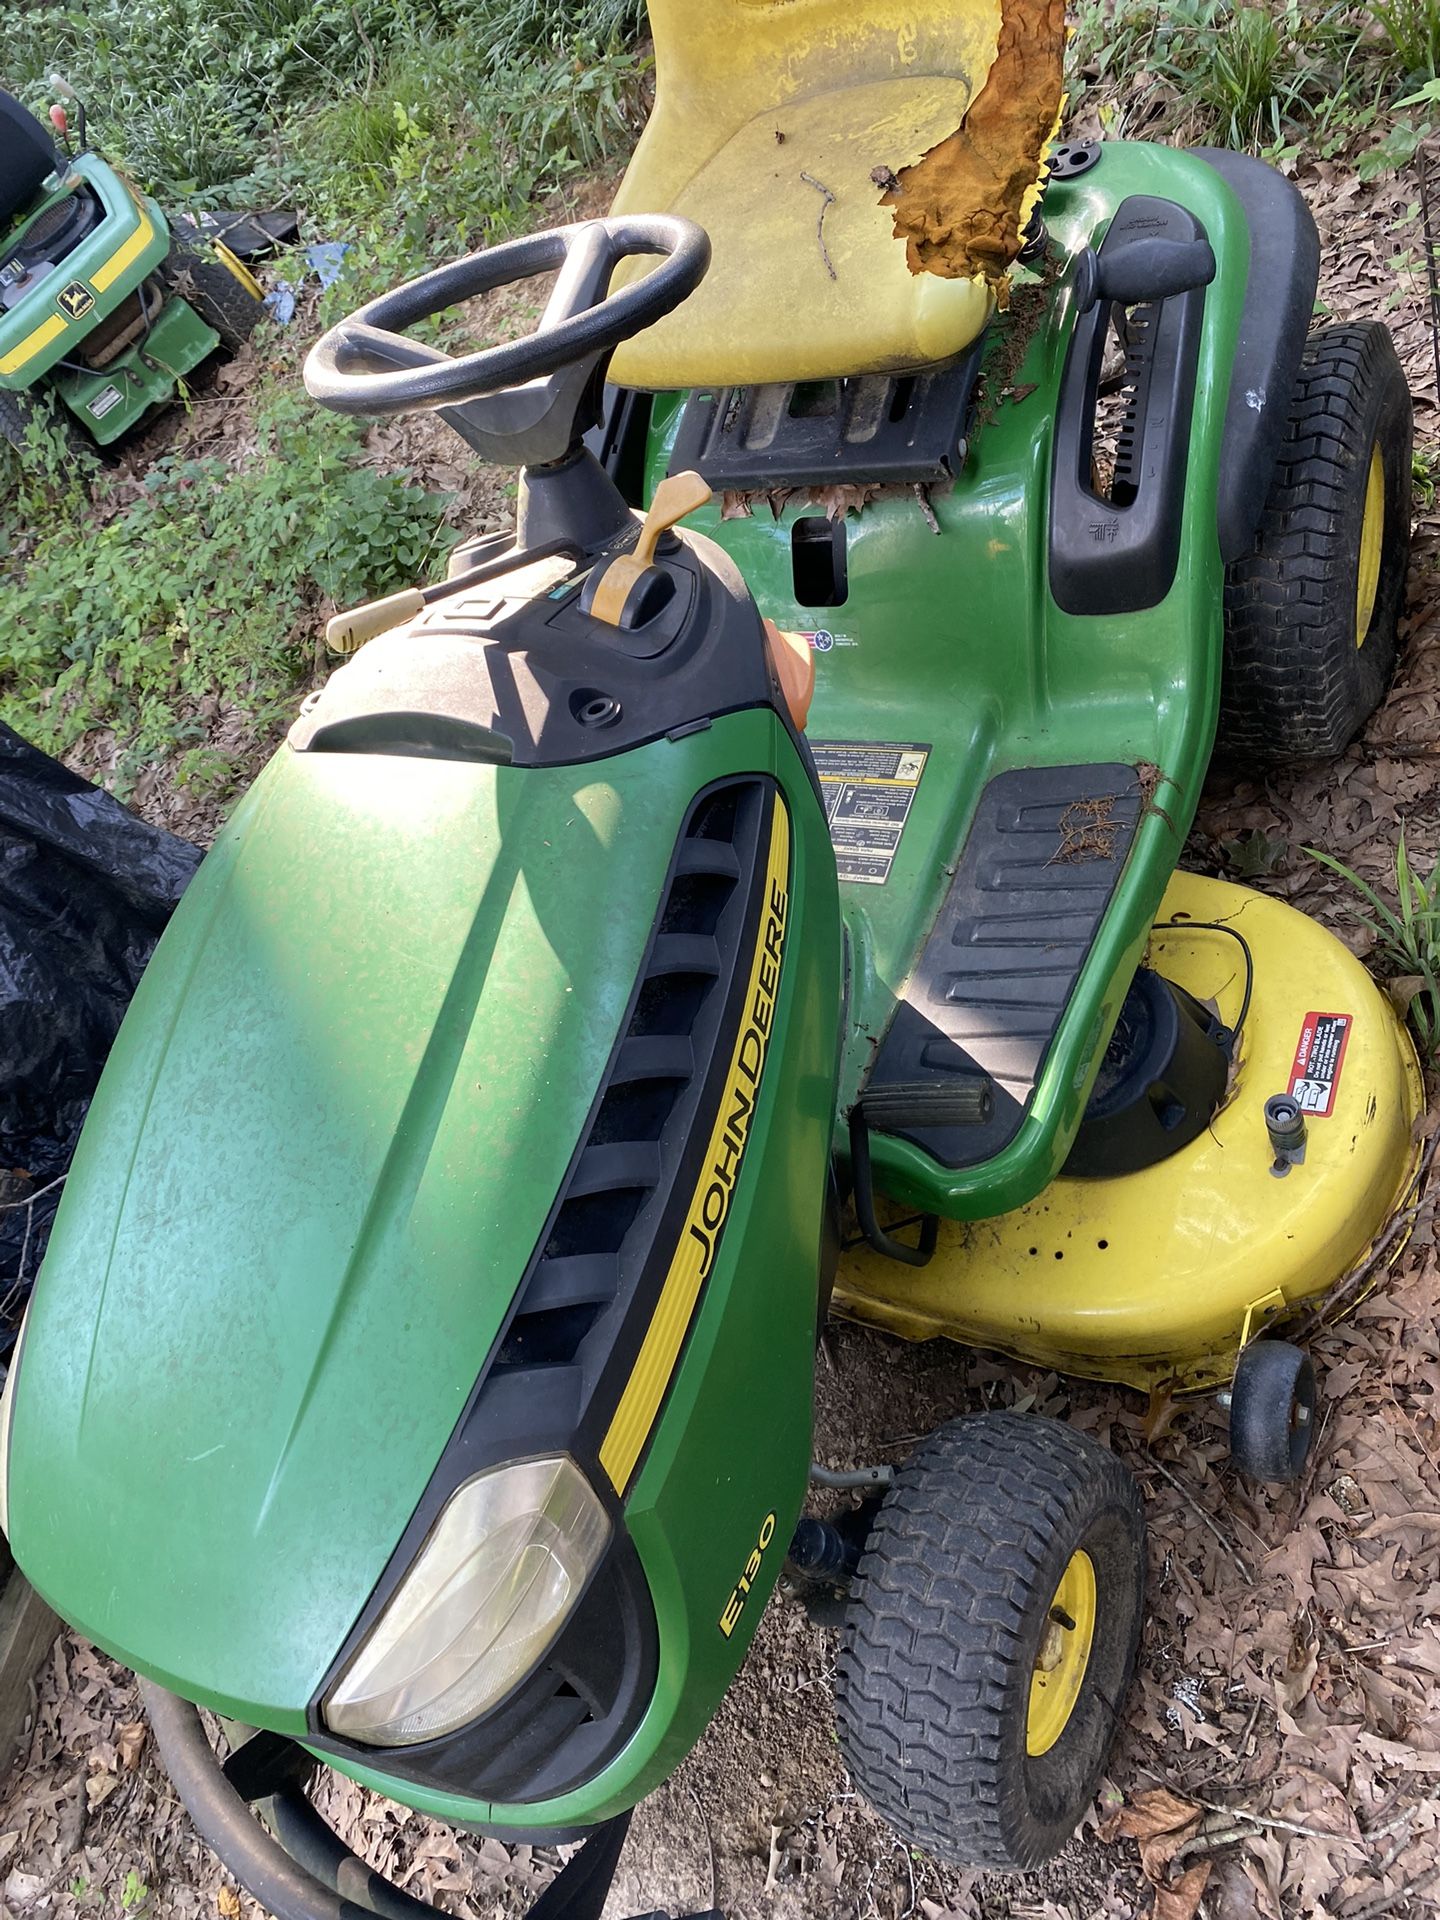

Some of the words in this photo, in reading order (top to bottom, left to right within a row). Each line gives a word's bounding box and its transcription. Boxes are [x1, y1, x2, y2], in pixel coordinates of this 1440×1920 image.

[1299, 1028, 1312, 1057] DANGER
[1314, 1026, 1324, 1045] BLADE
[690, 1088, 752, 1275] JOHN
[738, 877, 786, 1085] DEERE
[719, 1513, 776, 1638] E130
